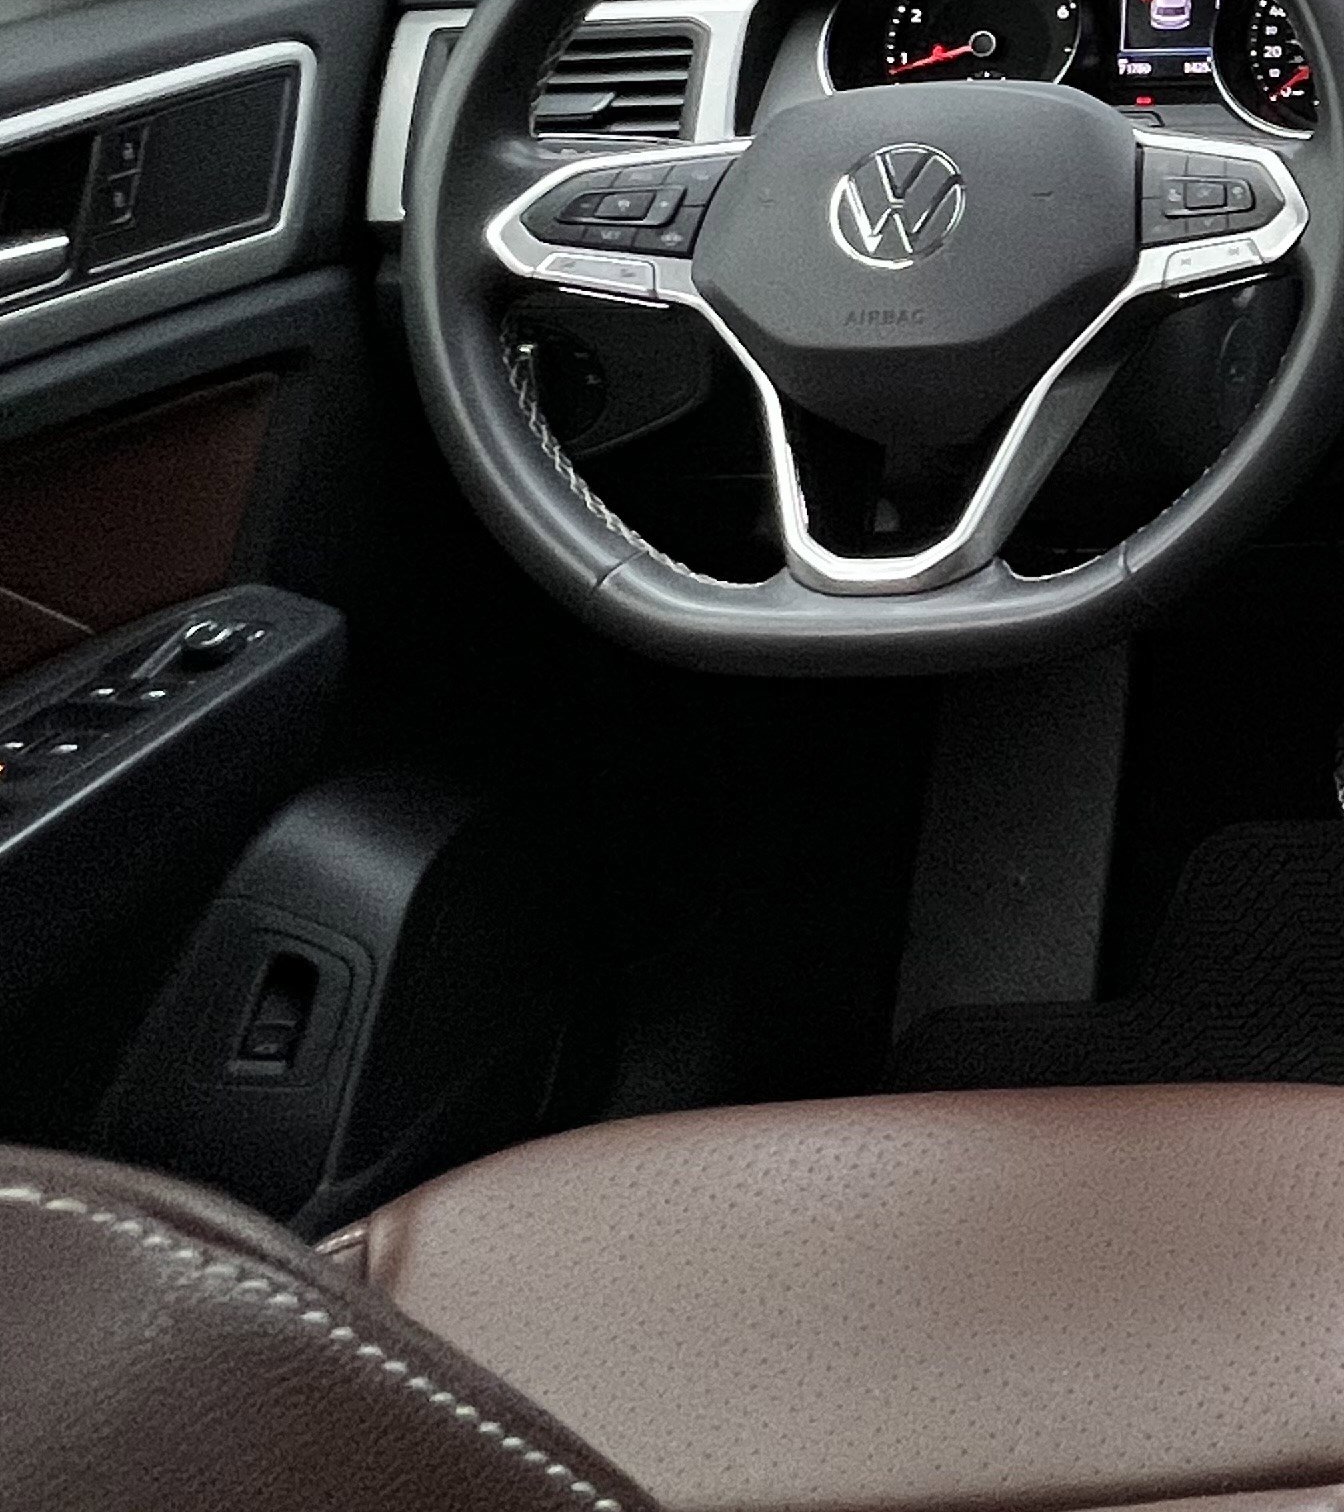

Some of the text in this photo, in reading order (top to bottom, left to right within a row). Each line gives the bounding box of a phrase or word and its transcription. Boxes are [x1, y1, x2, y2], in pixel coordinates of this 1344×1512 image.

[910, 9, 922, 23] 2
[1056, 5, 1070, 20] 6
[901, 52, 908, 65] 1
[1263, 45, 1282, 58] 20
[844, 309, 925, 326] AIRBAG
